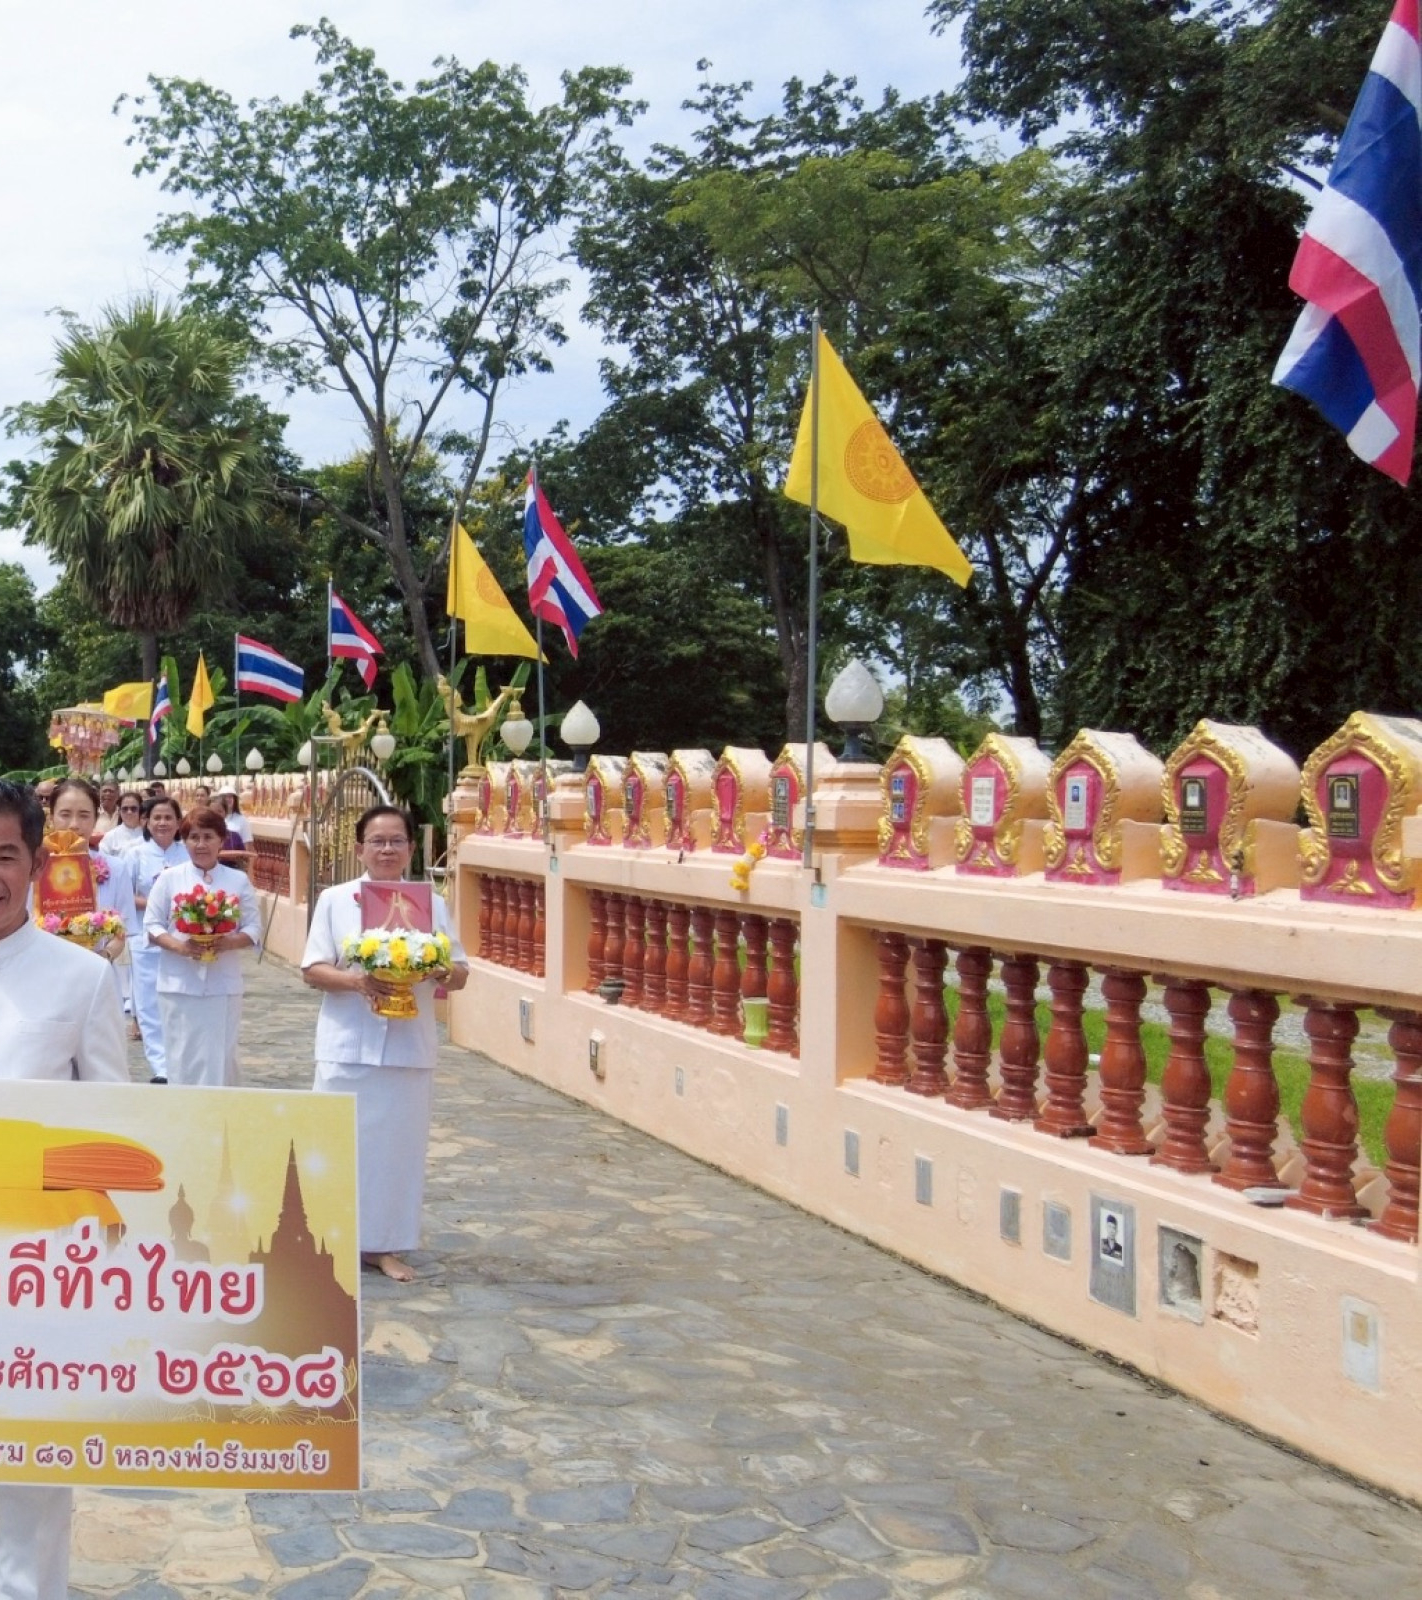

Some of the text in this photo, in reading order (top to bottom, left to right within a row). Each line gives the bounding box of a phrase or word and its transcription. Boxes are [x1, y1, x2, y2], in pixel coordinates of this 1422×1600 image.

[155, 1349, 338, 1399] ๒๕๖๘
[35, 1445, 74, 1466] ๘๑
[85, 1437, 104, 1466] ปี
[116, 1442, 327, 1472] หลวงพ่อธัมมชโย
